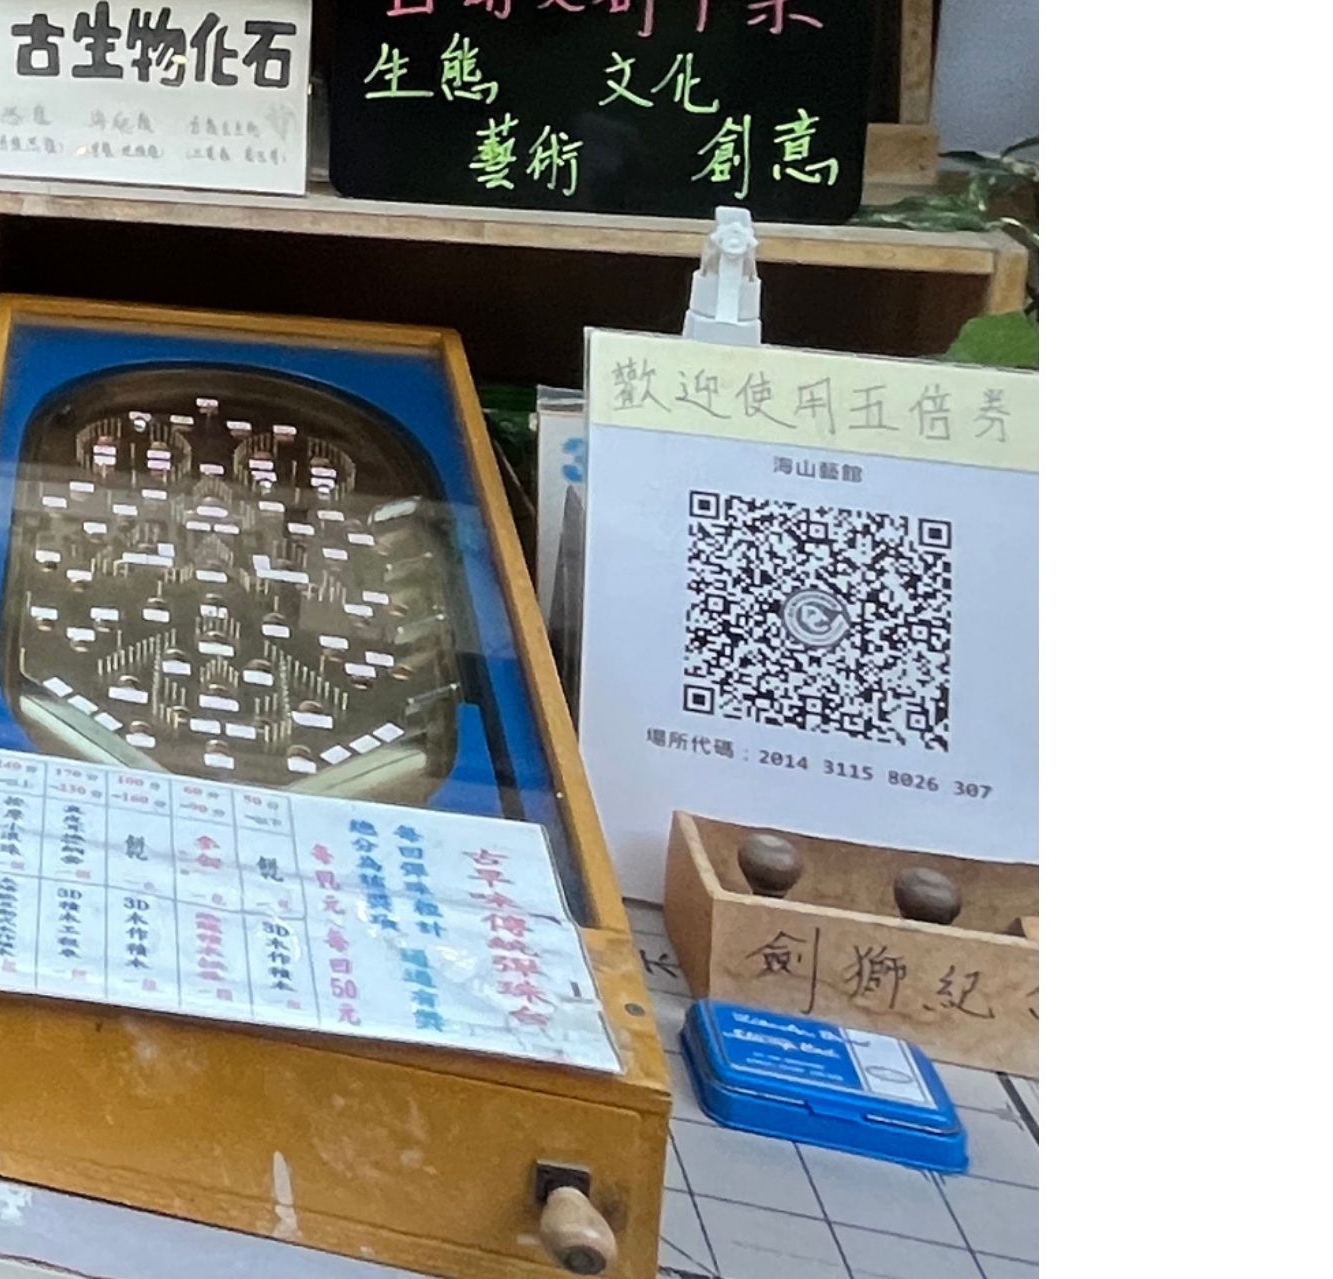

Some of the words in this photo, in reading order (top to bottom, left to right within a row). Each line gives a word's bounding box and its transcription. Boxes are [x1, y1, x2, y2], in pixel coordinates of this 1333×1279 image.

[10, 0, 297, 88] 古生物化石
[363, 32, 500, 104] 生態
[600, 50, 720, 116] 文化
[470, 117, 581, 197] 藝術
[691, 113, 839, 199] 創意
[610, 357, 1011, 444] 歡迎使用五倍券
[772, 455, 863, 484] 海山藝館
[758, 748, 809, 771] 2014
[822, 759, 874, 782] 3115
[887, 768, 940, 793] 8026
[953, 780, 993, 801] 307
[746, 926, 1039, 1020] 劍獅紀
